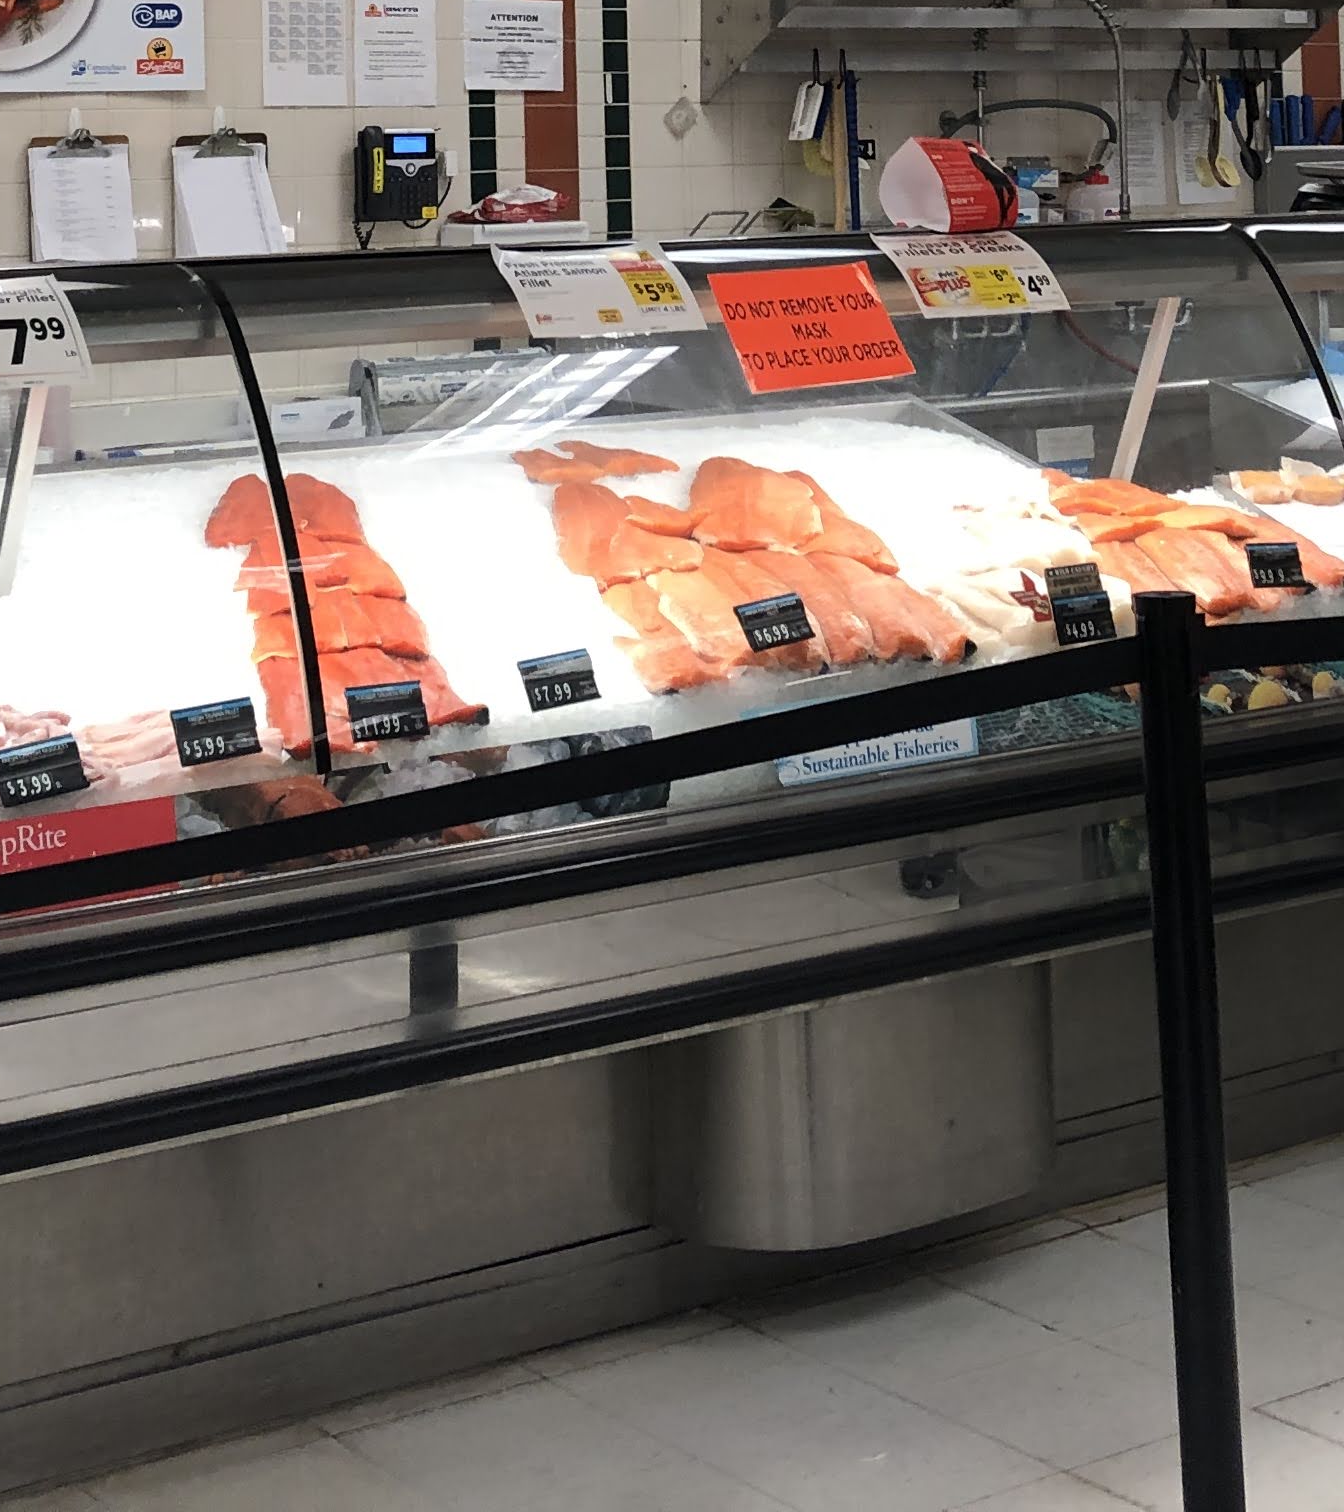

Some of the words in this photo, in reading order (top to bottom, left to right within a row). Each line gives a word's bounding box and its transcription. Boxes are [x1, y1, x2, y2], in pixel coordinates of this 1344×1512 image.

[155, 9, 179, 22] BAP
[490, 13, 539, 23] ATTENTION
[893, 246, 945, 258] Fillets
[950, 246, 966, 255] or
[512, 267, 560, 279] Atlantic
[562, 266, 607, 278] Salmon
[519, 277, 553, 289] Fillet
[16, 293, 58, 305] Fillet
[724, 301, 747, 322] DO
[748, 299, 781, 320] NOT
[781, 294, 838, 317] REMOVE
[838, 291, 878, 311] YOUR
[791, 321, 833, 342] MASK
[742, 352, 765, 372] TO
[767, 347, 814, 370] PLACE
[811, 344, 854, 366] YOUR
[854, 340, 902, 361] ORDER
[802, 743, 891, 776] Sustainable
[893, 734, 960, 761] Fisheries
